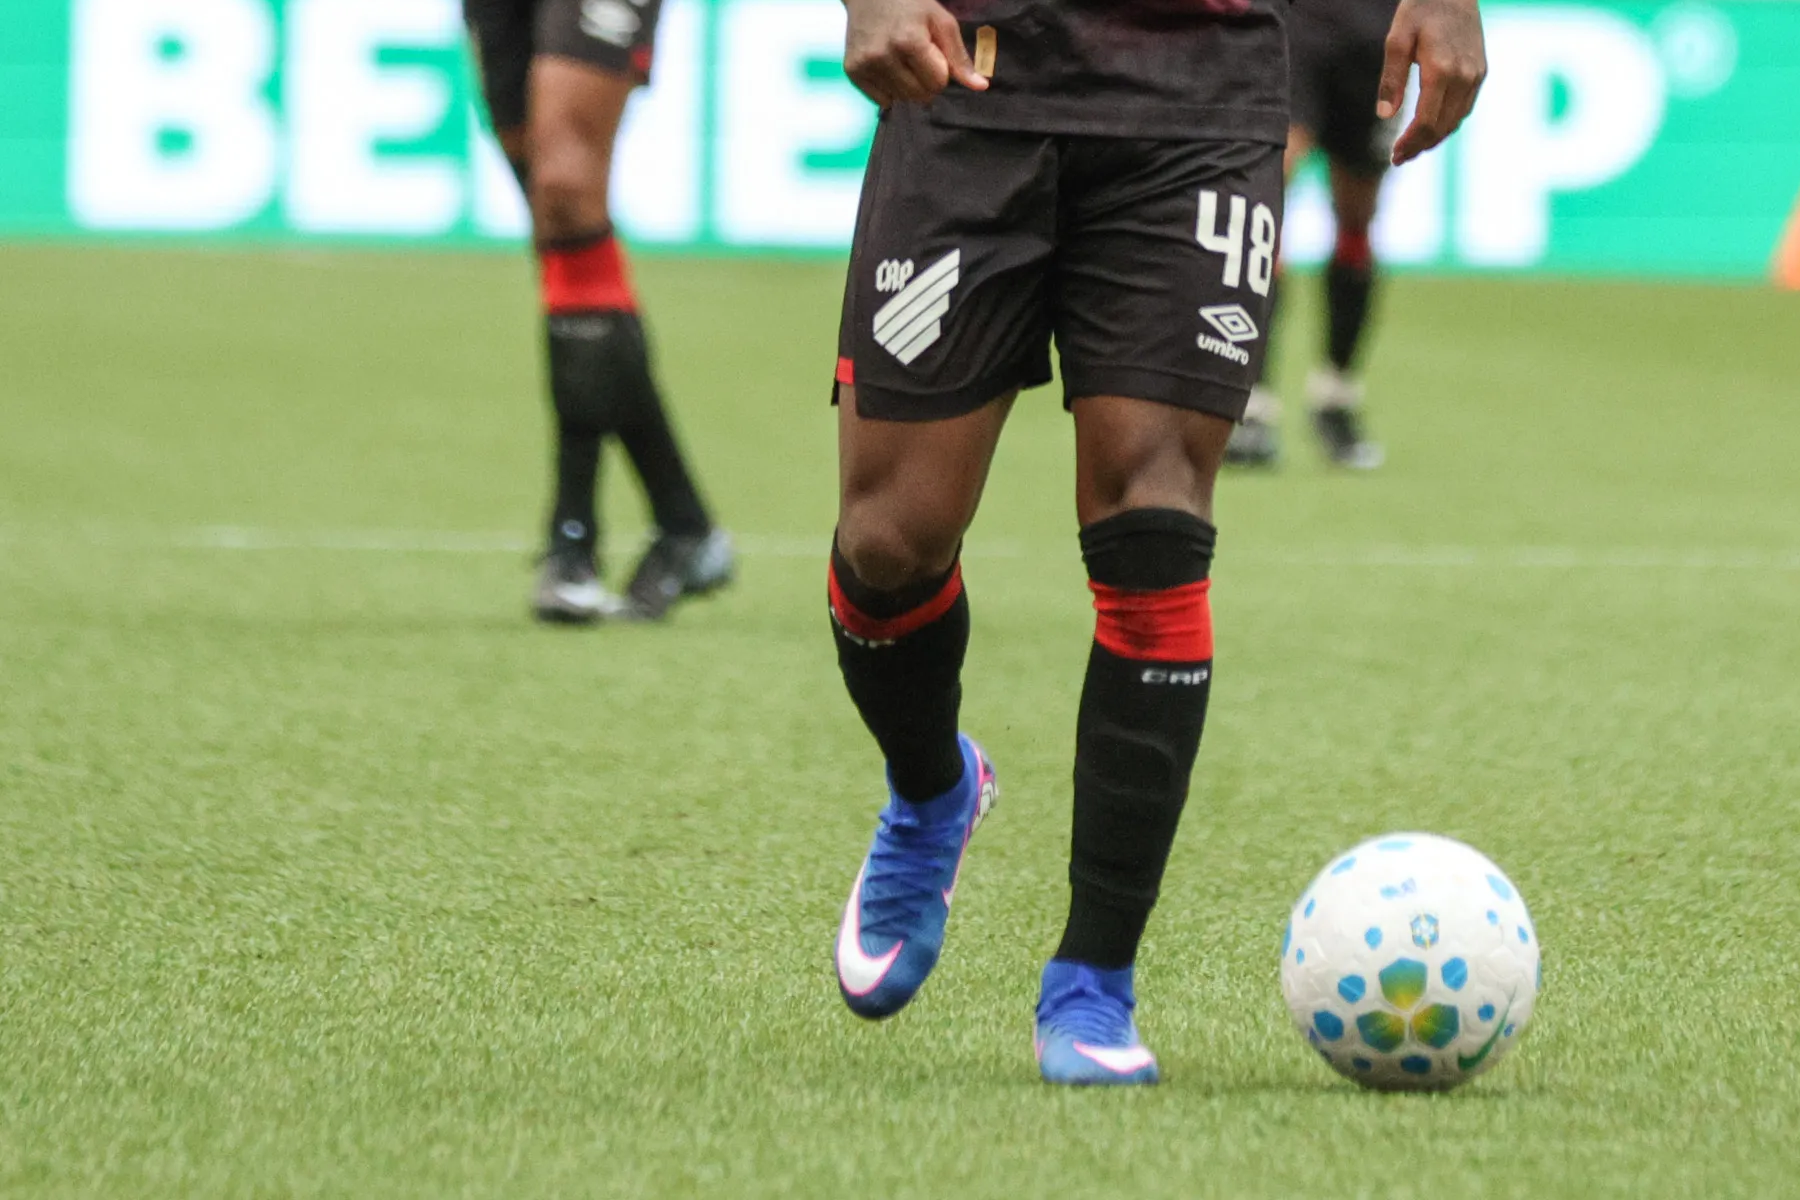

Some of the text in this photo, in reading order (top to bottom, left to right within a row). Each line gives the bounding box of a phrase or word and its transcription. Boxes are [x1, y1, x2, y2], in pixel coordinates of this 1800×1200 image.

[1196, 190, 1276, 298] 48
[875, 258, 915, 293] CAP
[1197, 332, 1250, 366] umbro
